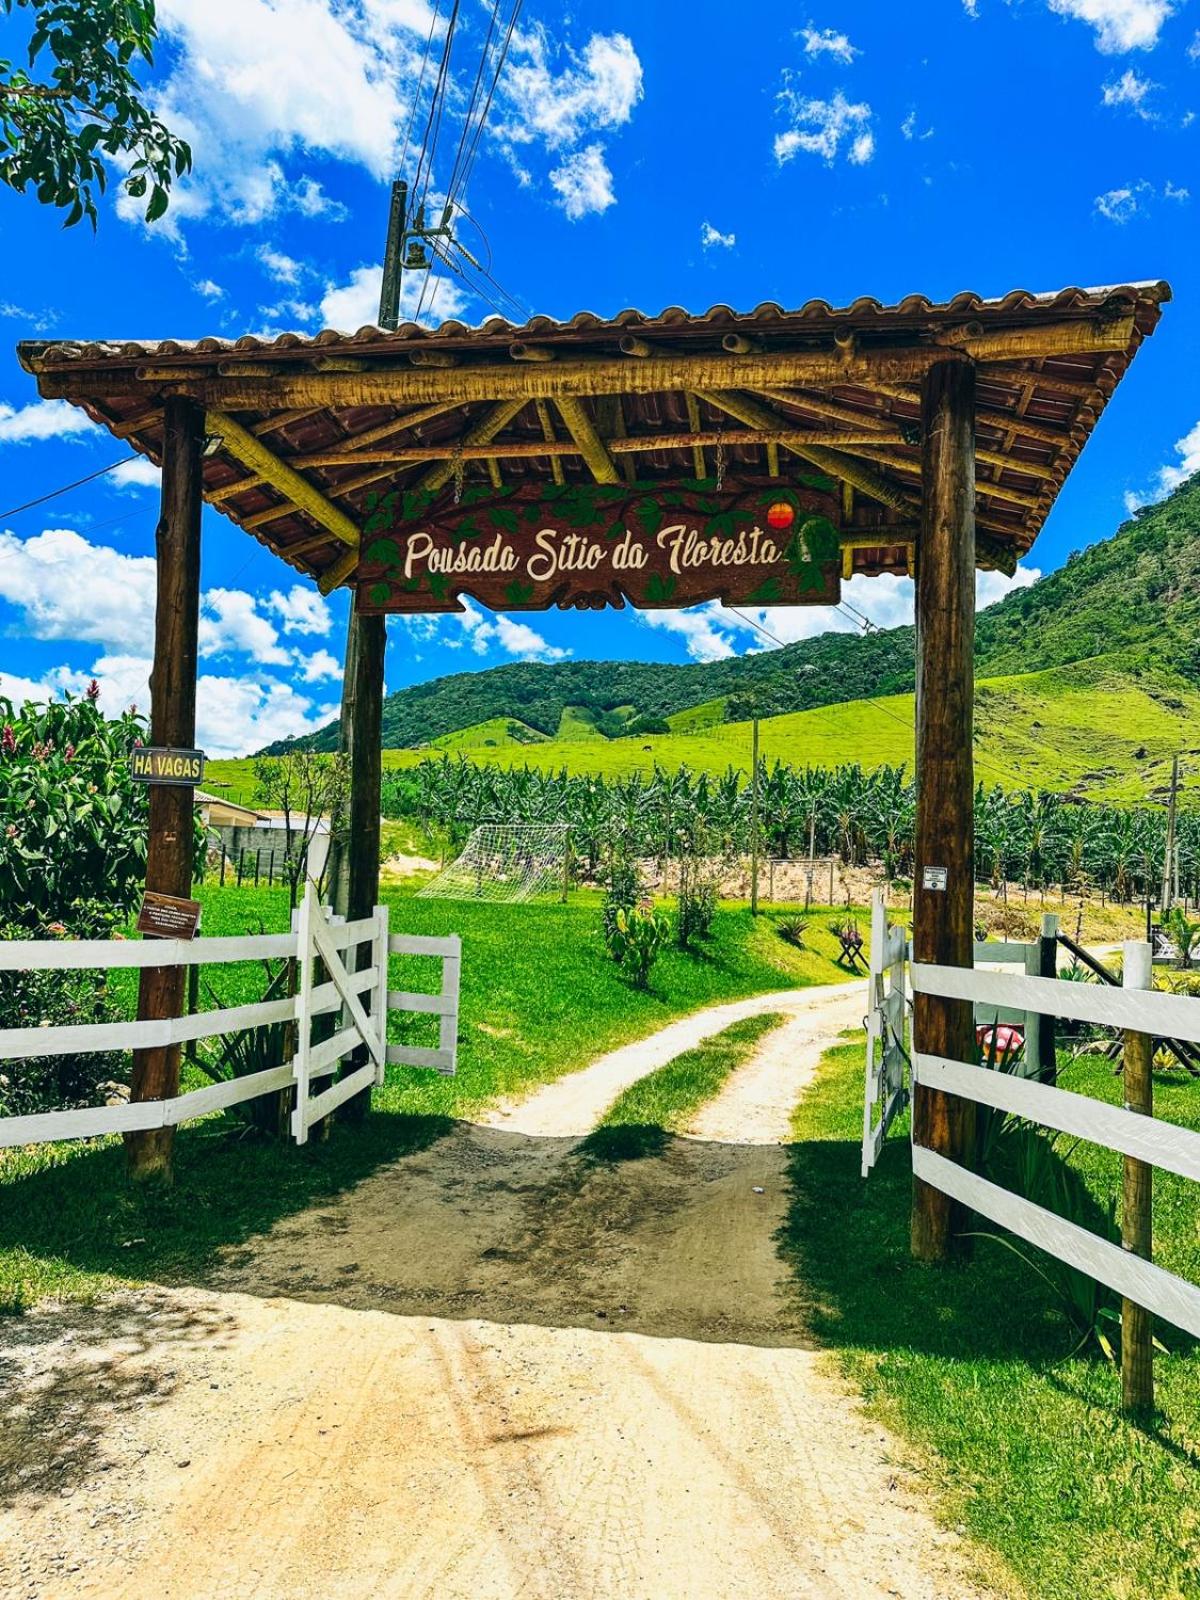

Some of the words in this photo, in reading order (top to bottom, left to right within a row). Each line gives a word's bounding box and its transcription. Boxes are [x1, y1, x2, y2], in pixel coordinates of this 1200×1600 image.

[404, 532, 520, 579] Pousada
[612, 529, 649, 570] da
[656, 524, 783, 575] Floresta
[134, 752, 153, 775] HÁ
[157, 756, 200, 778] VAGAS
